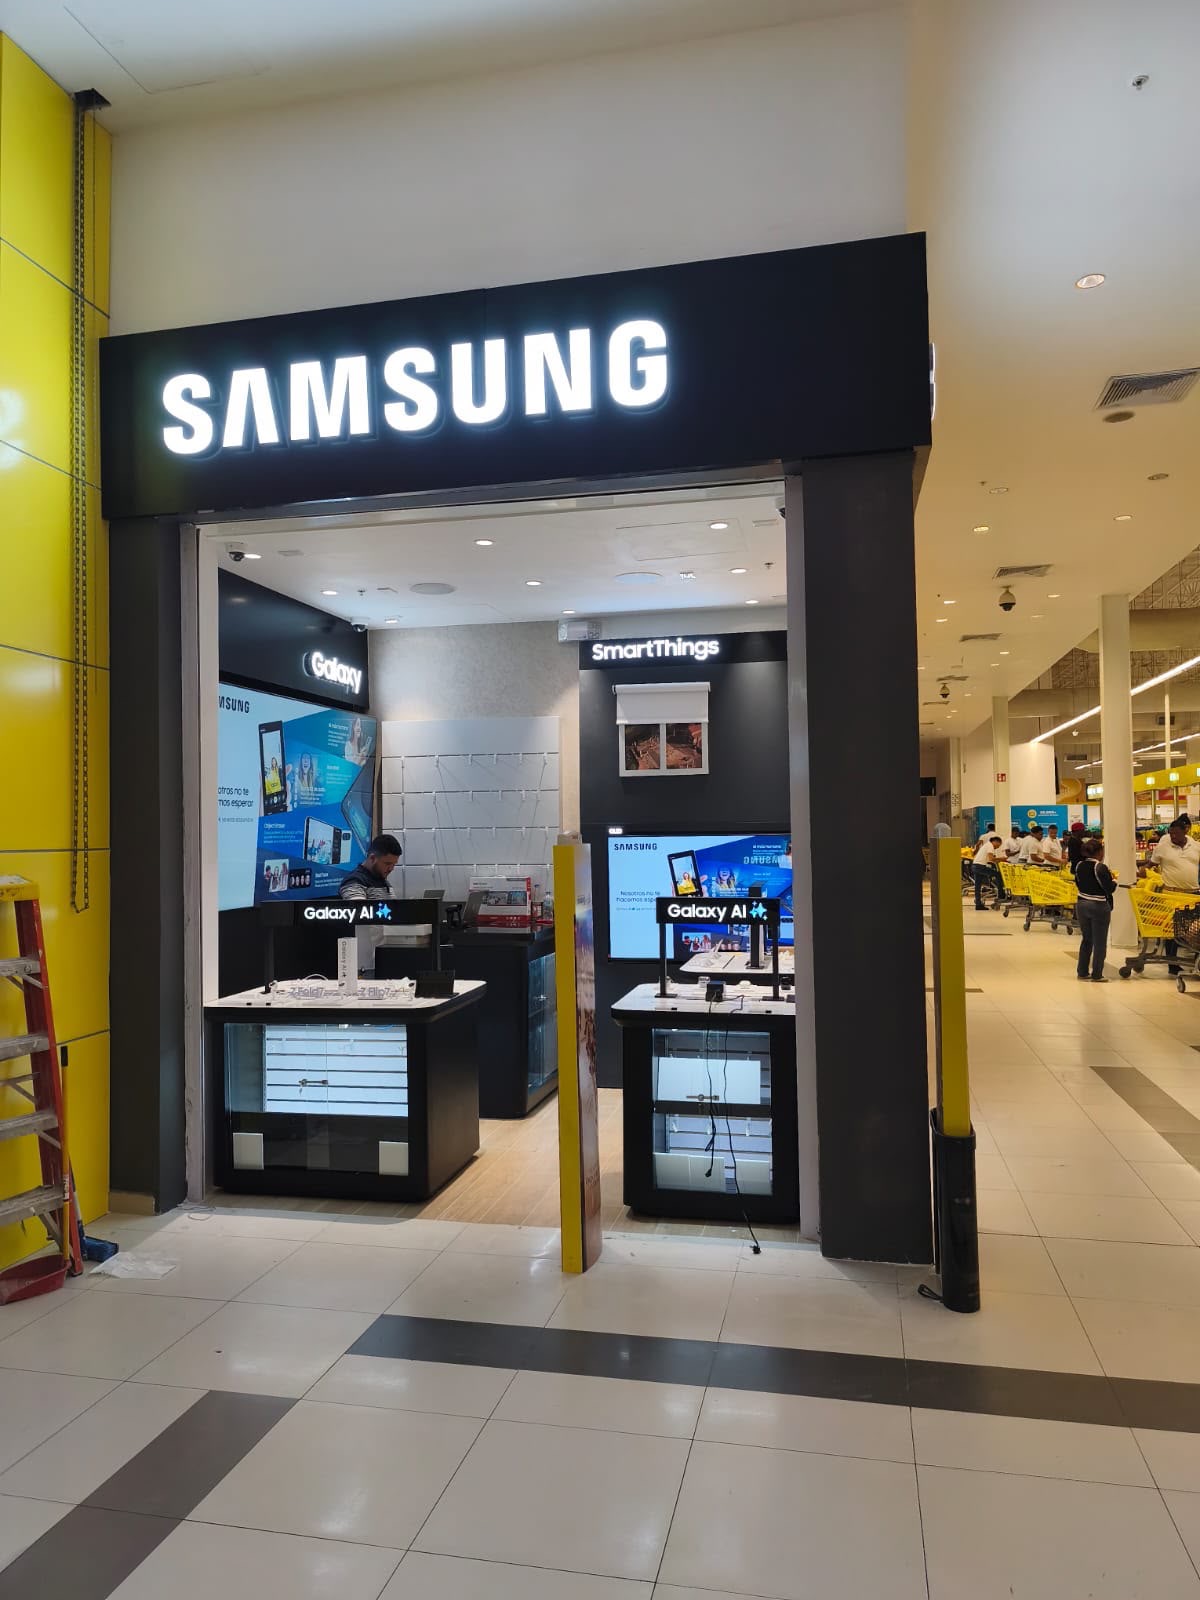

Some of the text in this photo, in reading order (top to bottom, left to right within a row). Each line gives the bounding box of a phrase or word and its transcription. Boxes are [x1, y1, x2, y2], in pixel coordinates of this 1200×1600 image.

[163, 319, 668, 455] SAMSUNG
[592, 637, 720, 661] SmartThings
[311, 651, 362, 695] Galaxy
[614, 843, 658, 851] SAMSUNG
[304, 906, 373, 923] Galaxy AI
[667, 903, 747, 922] Galaxy AI
